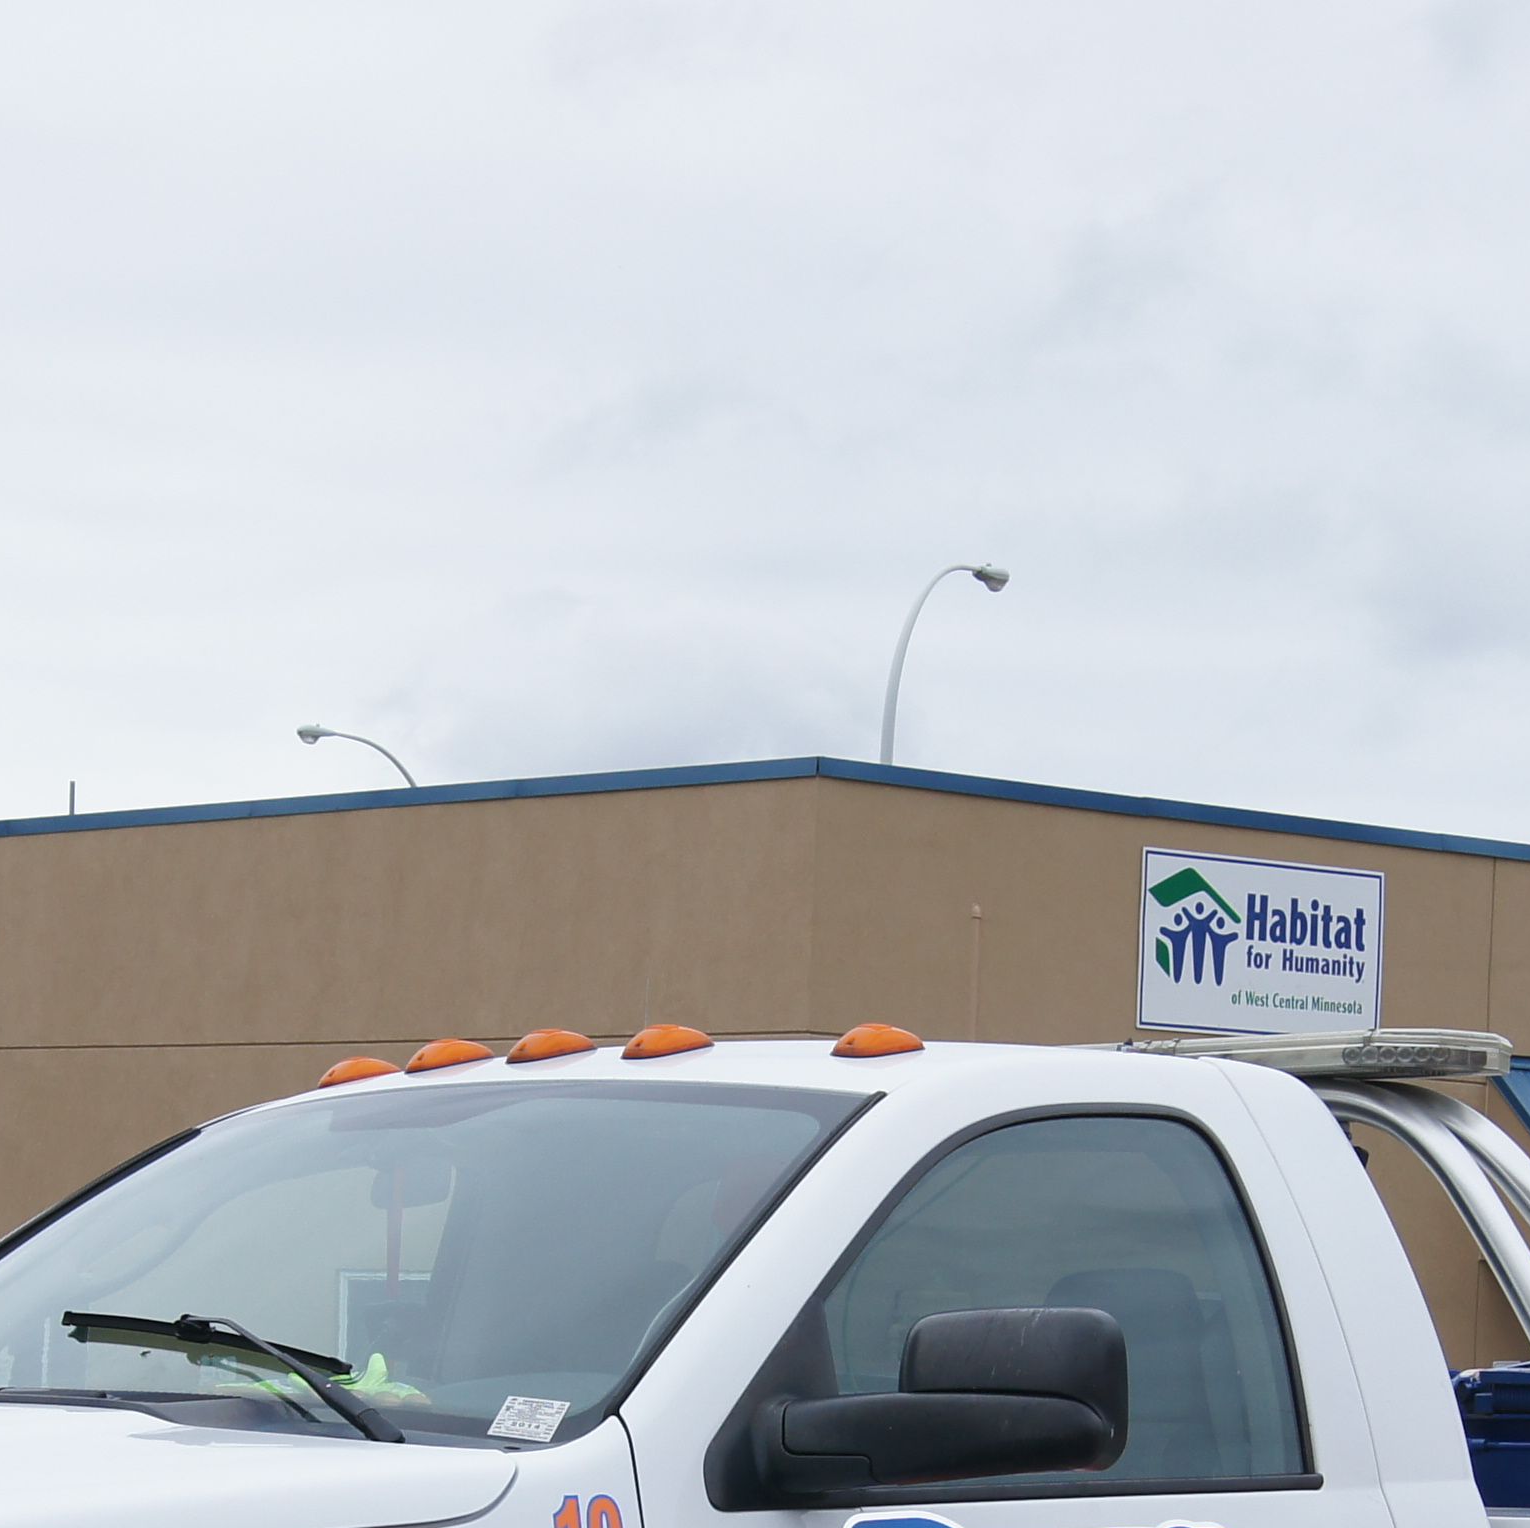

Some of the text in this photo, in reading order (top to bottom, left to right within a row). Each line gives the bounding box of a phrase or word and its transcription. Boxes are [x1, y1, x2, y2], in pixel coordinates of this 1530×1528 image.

[1246, 893, 1366, 951] Habitat
[1247, 945, 1365, 983] for Humanity
[1231, 989, 1363, 1015] of West Central Minnesota
